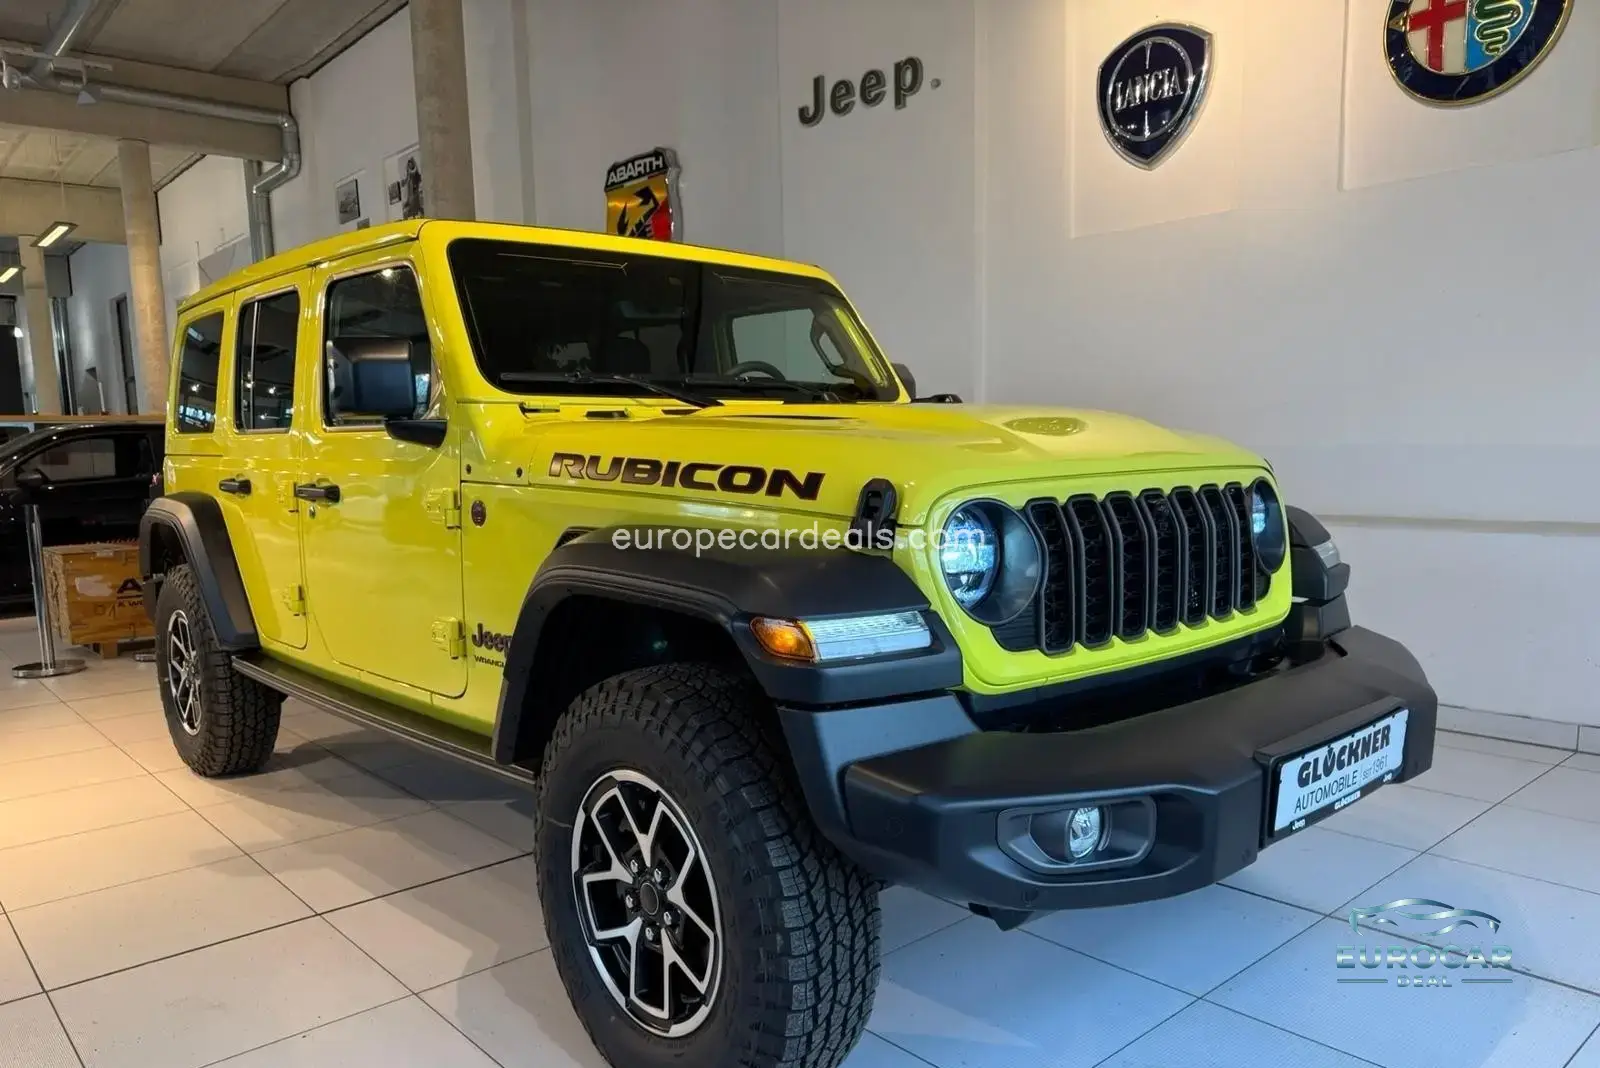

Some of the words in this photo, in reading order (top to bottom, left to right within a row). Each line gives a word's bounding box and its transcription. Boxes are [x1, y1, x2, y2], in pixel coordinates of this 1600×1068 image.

[1115, 66, 1184, 112] LANCIA
[607, 156, 664, 186] ABARTH
[549, 452, 826, 501] RUBICON
[1294, 769, 1358, 814] AUTOMOBILE
